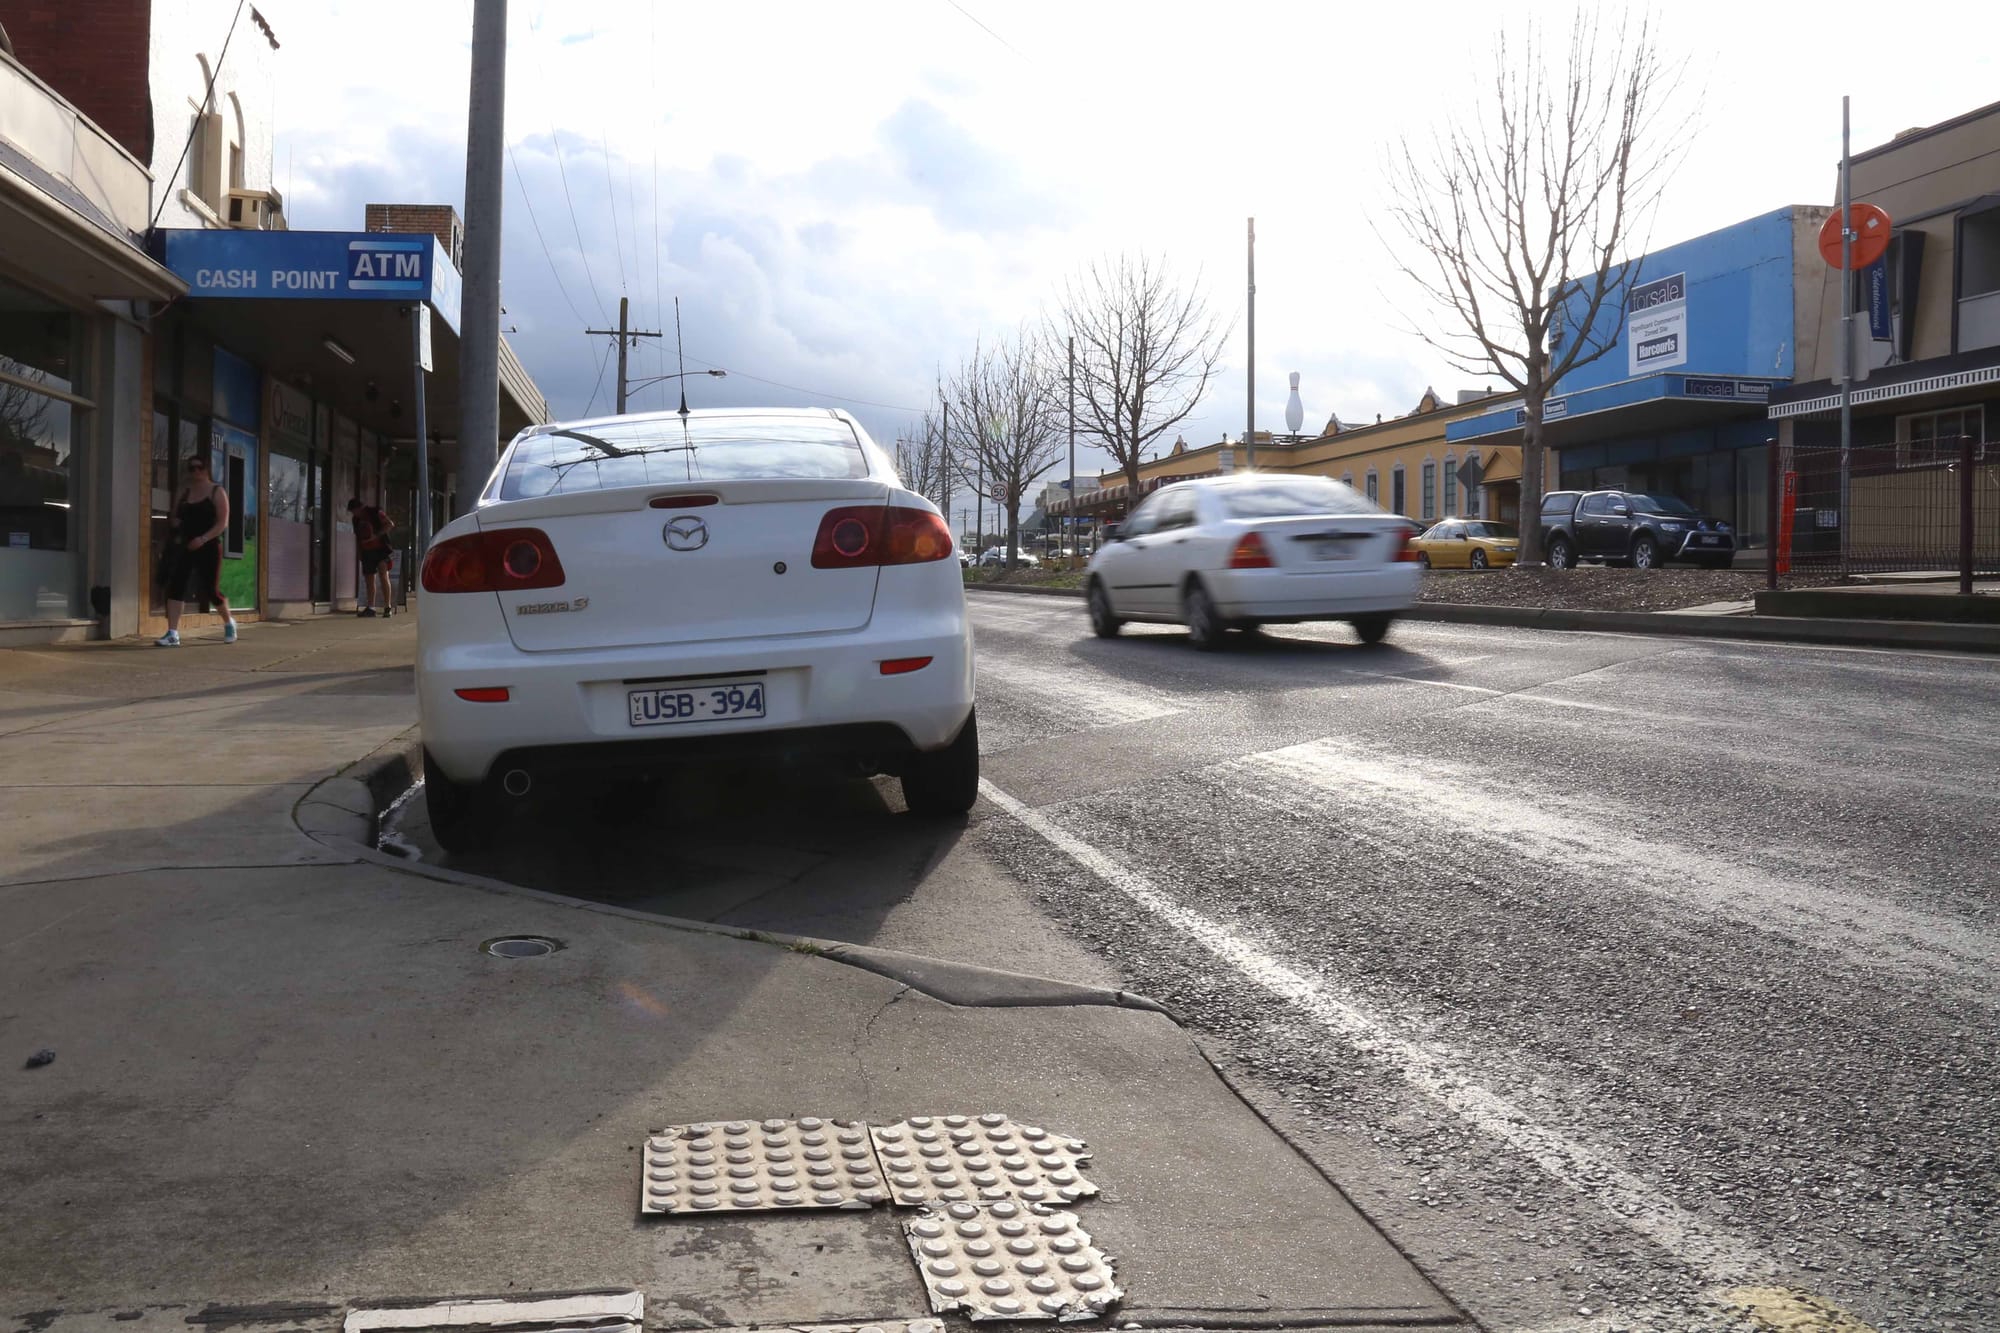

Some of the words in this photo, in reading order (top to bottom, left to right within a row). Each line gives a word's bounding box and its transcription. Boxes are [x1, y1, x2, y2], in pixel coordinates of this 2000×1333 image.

[354, 253, 420, 277] ATM
[196, 269, 257, 289] CASH
[271, 270, 340, 289] POINT
[1654, 313, 1681, 327] Commercial
[1639, 337, 1676, 359] Harcourts
[1739, 383, 1770, 394] Harcourts
[211, 431, 224, 450] ATM
[993, 487, 1005, 497] 50
[633, 696, 642, 721] VIC
